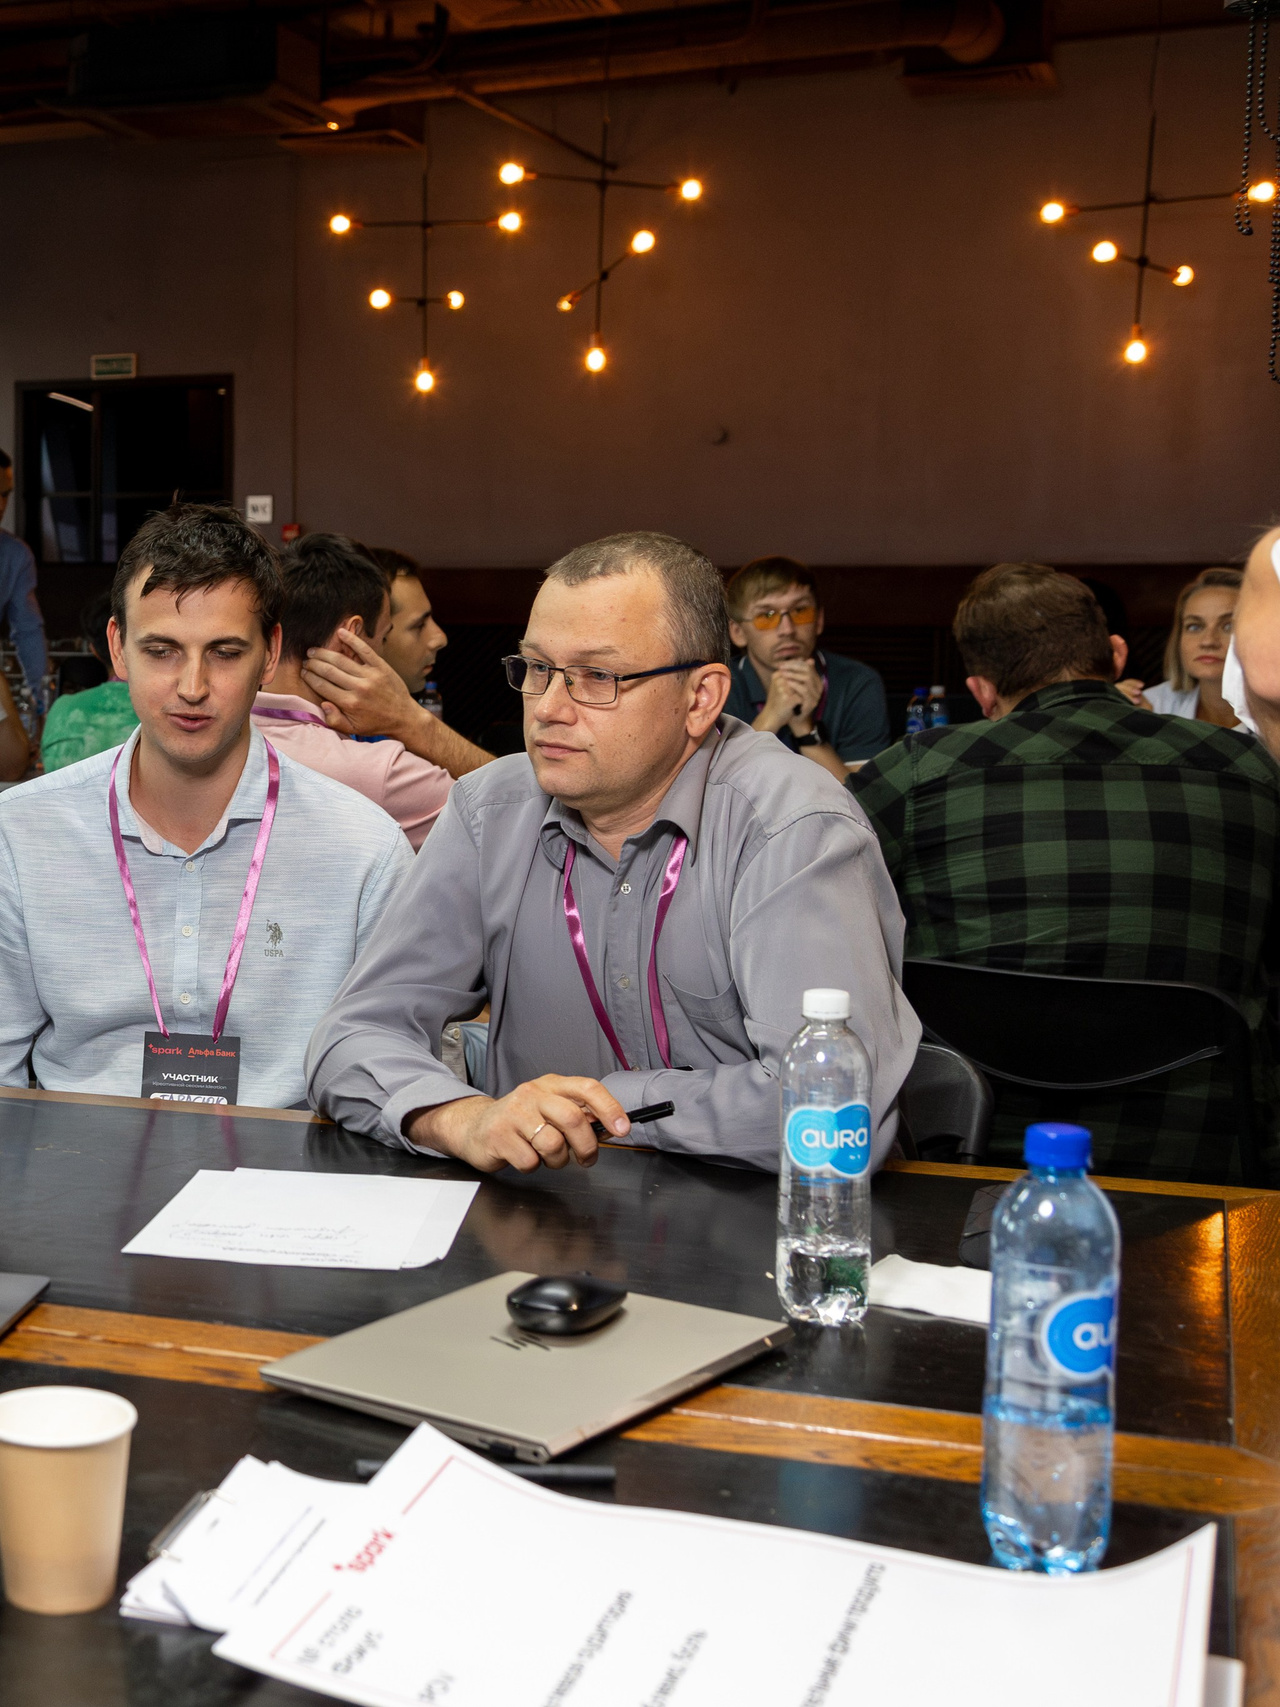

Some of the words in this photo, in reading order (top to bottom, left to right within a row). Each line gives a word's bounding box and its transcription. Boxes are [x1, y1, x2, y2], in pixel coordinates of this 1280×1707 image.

[263, 949, 285, 957] USPA
[188, 1047, 215, 1058] Альфа
[215, 1048, 236, 1058] Банк
[161, 1072, 219, 1083] УЧАСТНИК
